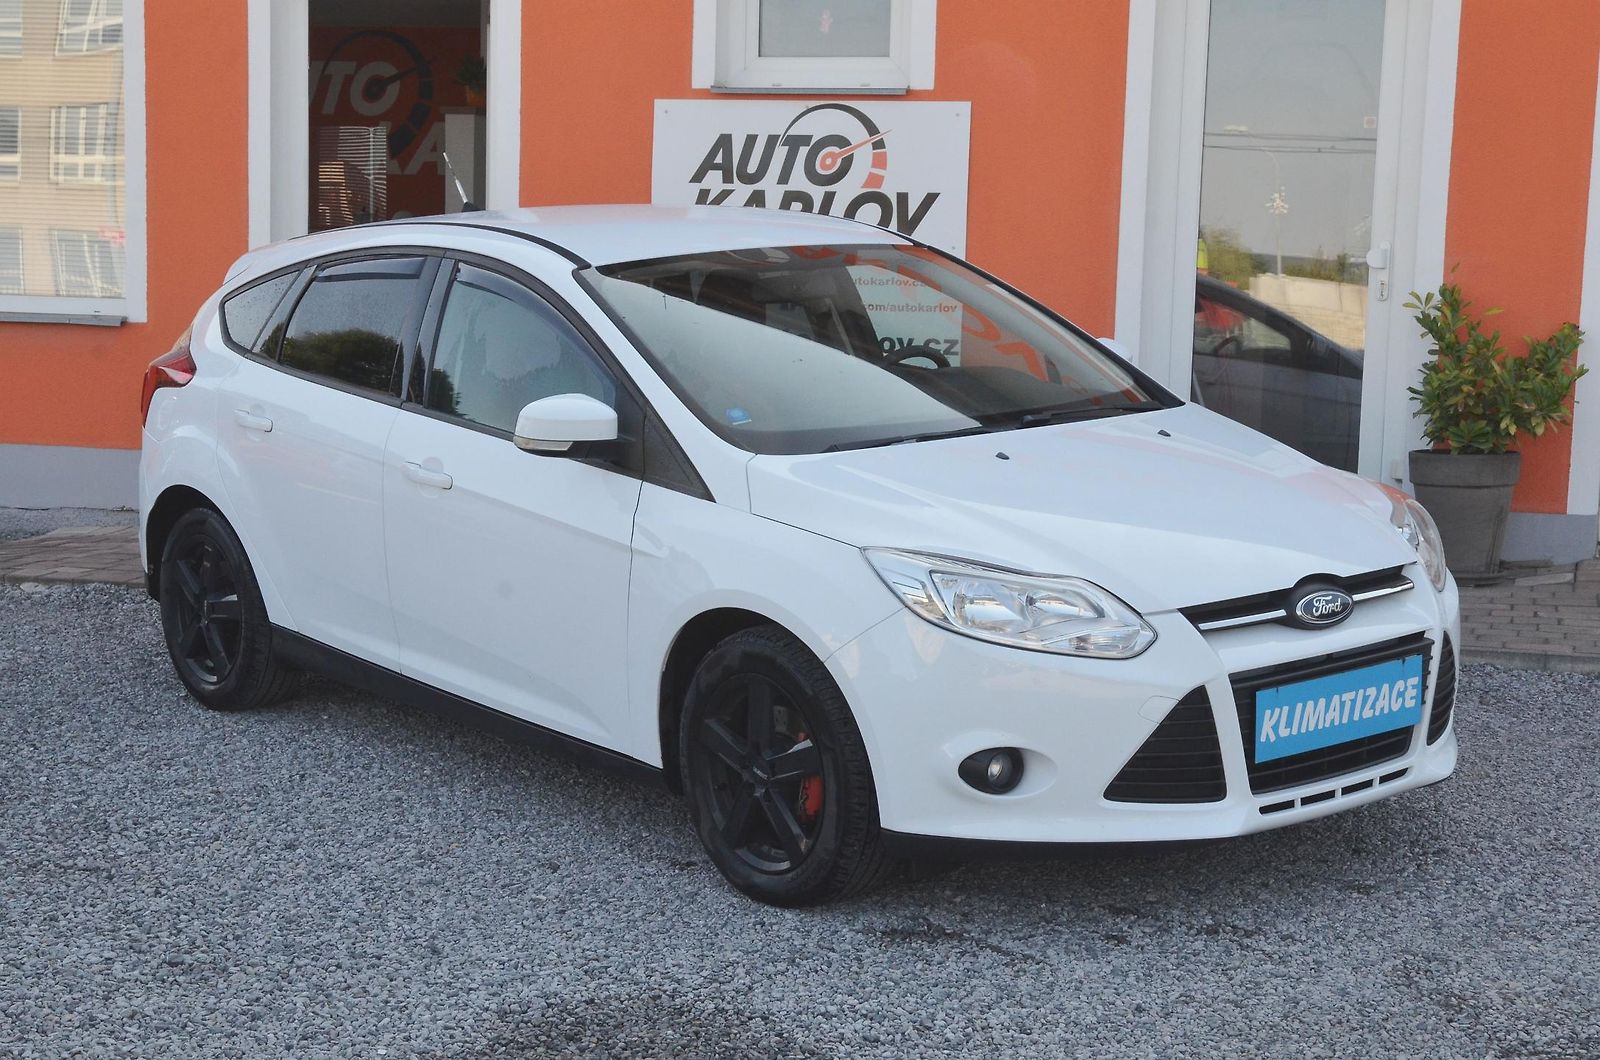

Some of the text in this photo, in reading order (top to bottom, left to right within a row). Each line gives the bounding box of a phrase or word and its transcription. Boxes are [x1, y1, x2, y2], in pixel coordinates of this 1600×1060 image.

[689, 133, 854, 186] AUTO
[864, 302, 958, 313] om/autokarlov
[879, 336, 960, 356] ovcz
[1312, 595, 1343, 617] Ford
[1260, 676, 1419, 743] KLIMATIZACE
